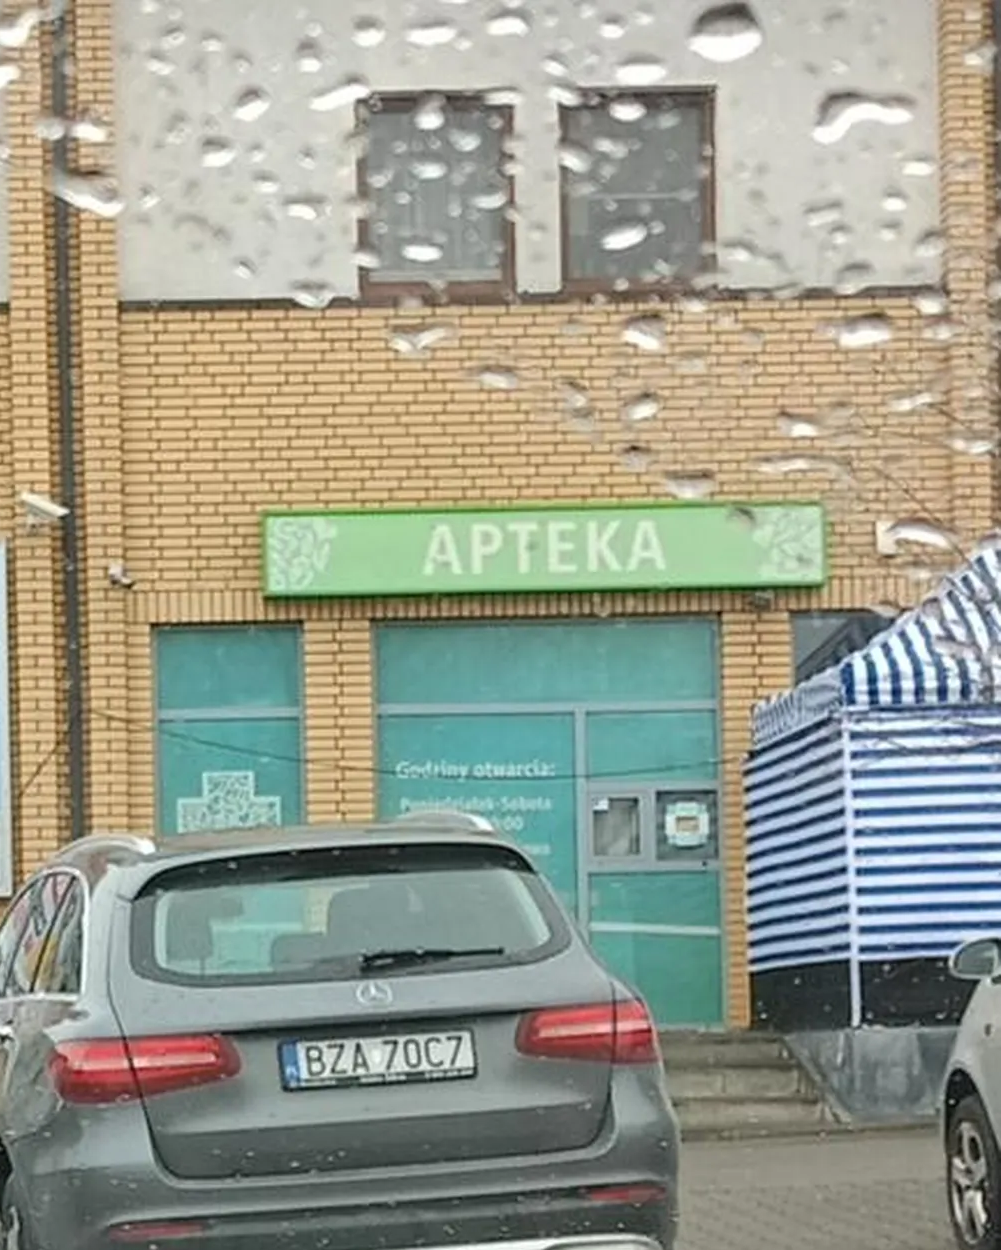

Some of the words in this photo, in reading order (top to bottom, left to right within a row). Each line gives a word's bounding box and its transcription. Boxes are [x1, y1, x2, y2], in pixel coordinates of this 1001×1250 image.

[422, 519, 667, 576] APTEKA
[305, 1042, 370, 1078] BZA
[383, 1035, 464, 1072] 70C7
